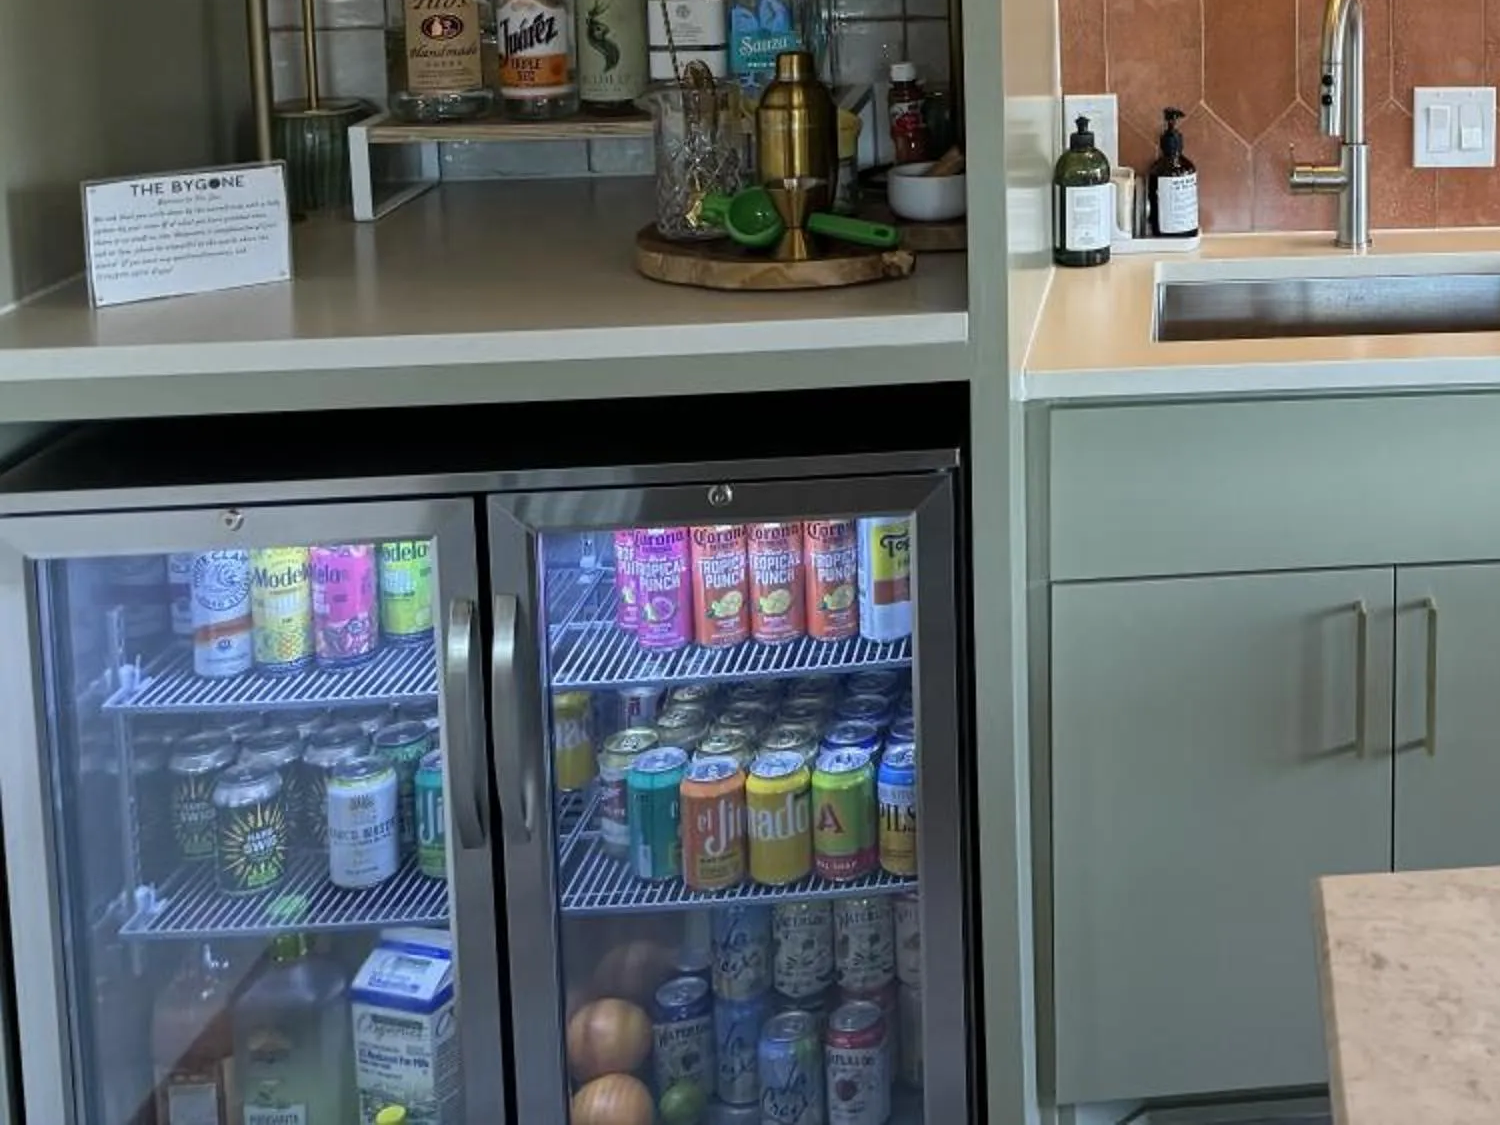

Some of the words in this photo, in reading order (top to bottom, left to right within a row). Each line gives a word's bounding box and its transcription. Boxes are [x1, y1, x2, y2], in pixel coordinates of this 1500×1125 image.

[409, 43, 478, 60] Handmade
[739, 36, 789, 57] Sauza
[130, 182, 165, 197] THE
[171, 175, 246, 194] BYGONE
[696, 807, 712, 832] el
[816, 802, 845, 834] A
